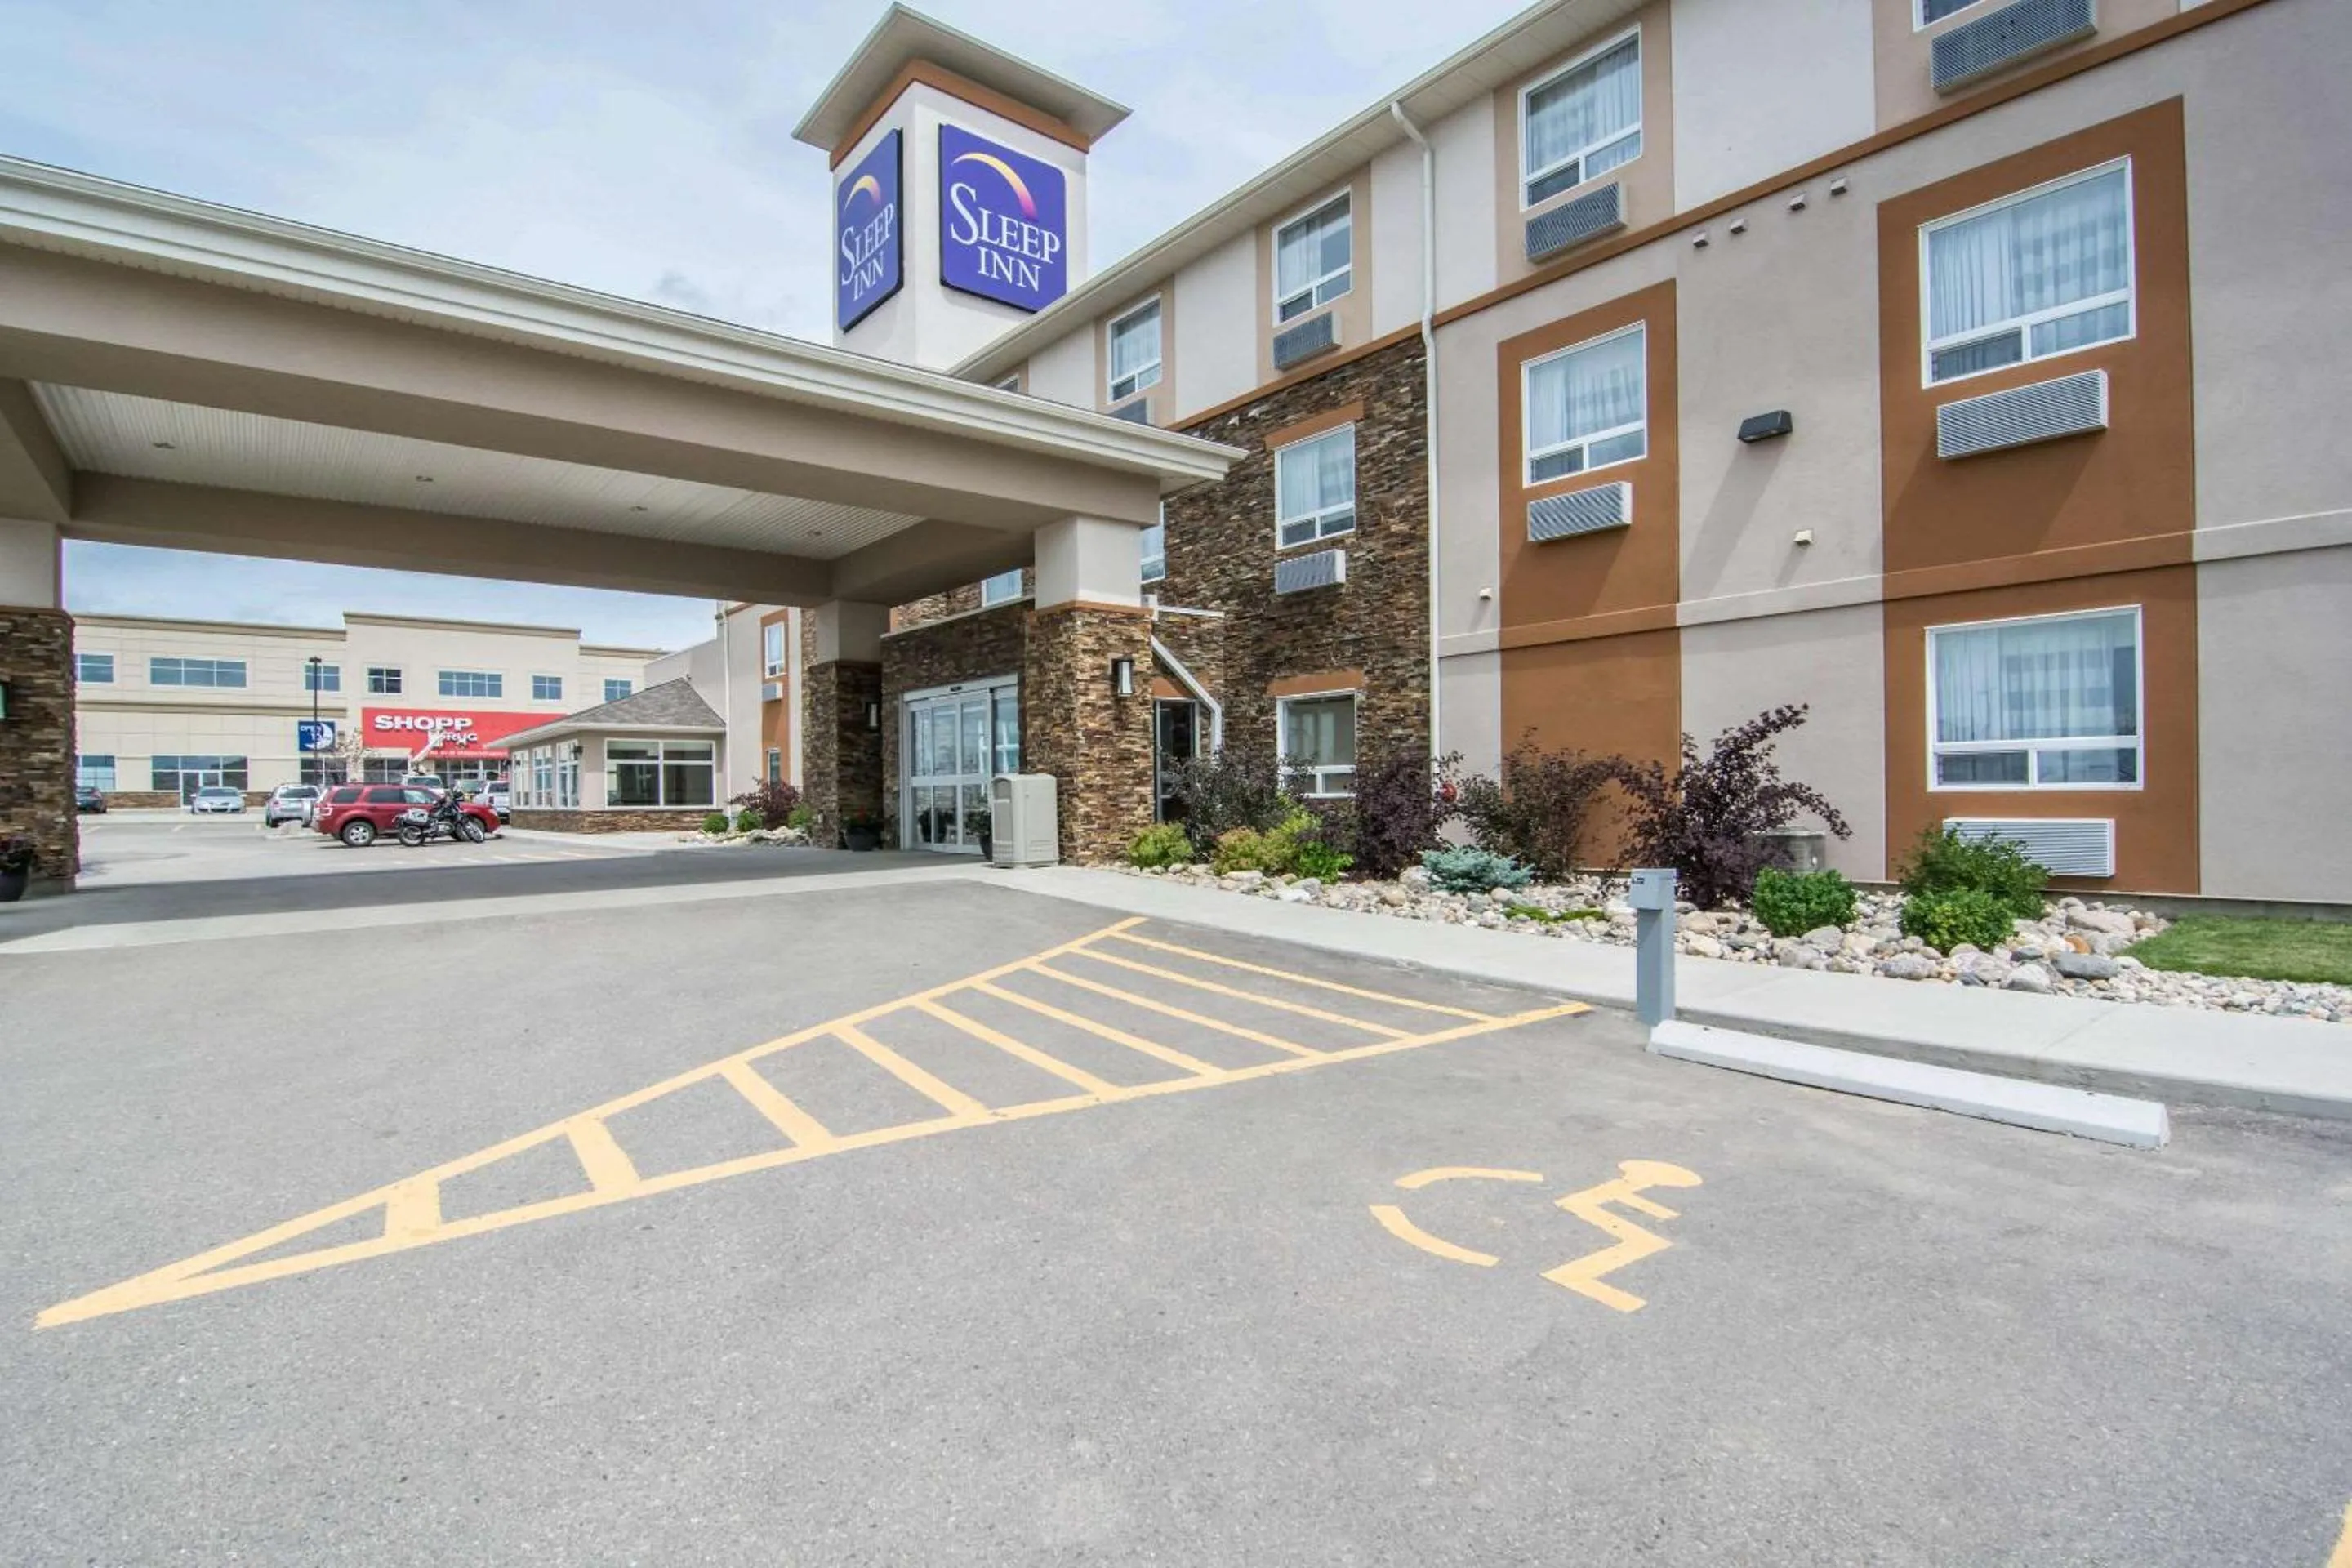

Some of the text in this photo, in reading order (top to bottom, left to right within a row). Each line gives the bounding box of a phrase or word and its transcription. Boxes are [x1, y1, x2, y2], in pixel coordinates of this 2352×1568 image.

[841, 203, 894, 287] SLEEP
[950, 182, 1061, 264] SLEEP
[853, 251, 884, 301] INN
[978, 245, 1041, 292] INN
[375, 715, 473, 730] SHOPP
